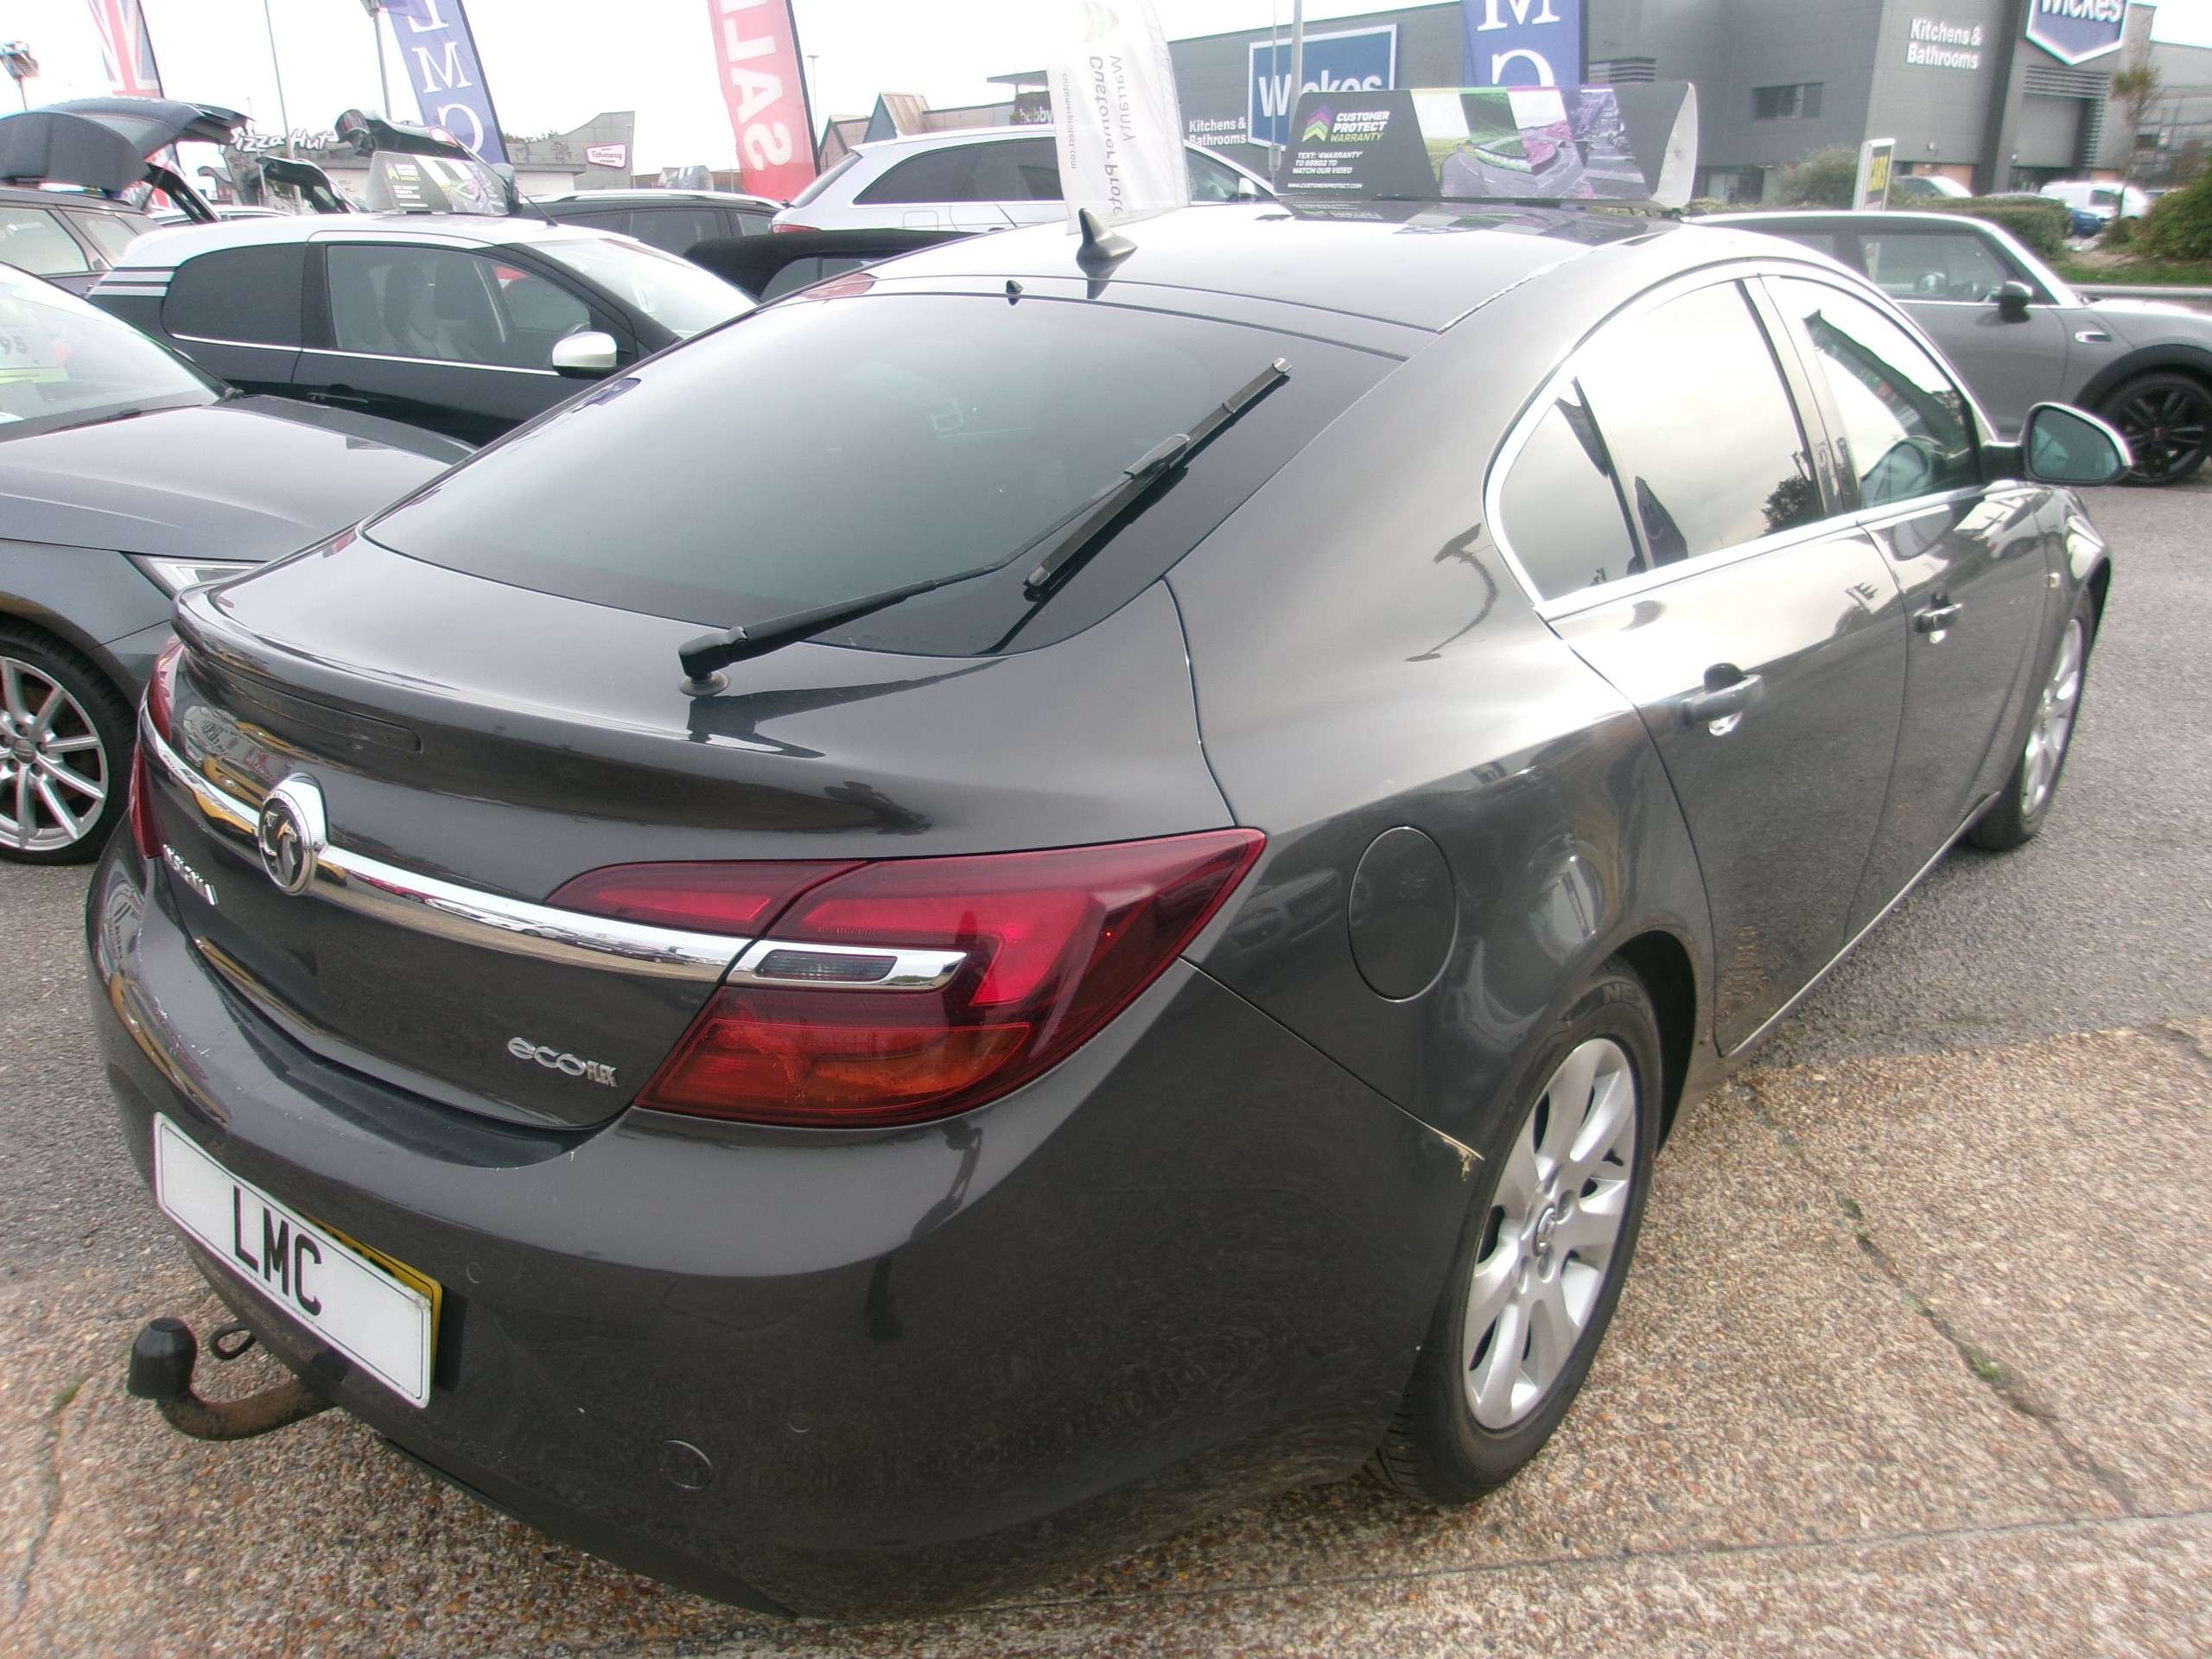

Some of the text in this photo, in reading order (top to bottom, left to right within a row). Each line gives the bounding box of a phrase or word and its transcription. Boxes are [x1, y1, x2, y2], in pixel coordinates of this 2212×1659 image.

[1910, 18, 1981, 46] Kitchens &
[1906, 43, 1980, 69] Bathrooms
[1336, 111, 1390, 122] CUSTOMER
[1188, 117, 1246, 133] Kitchens &
[1332, 121, 1388, 133] PROTECT
[1188, 134, 1246, 145] Bathrooms
[1330, 132, 1383, 143] WARRANTY
[233, 1185, 322, 1316] LMC
